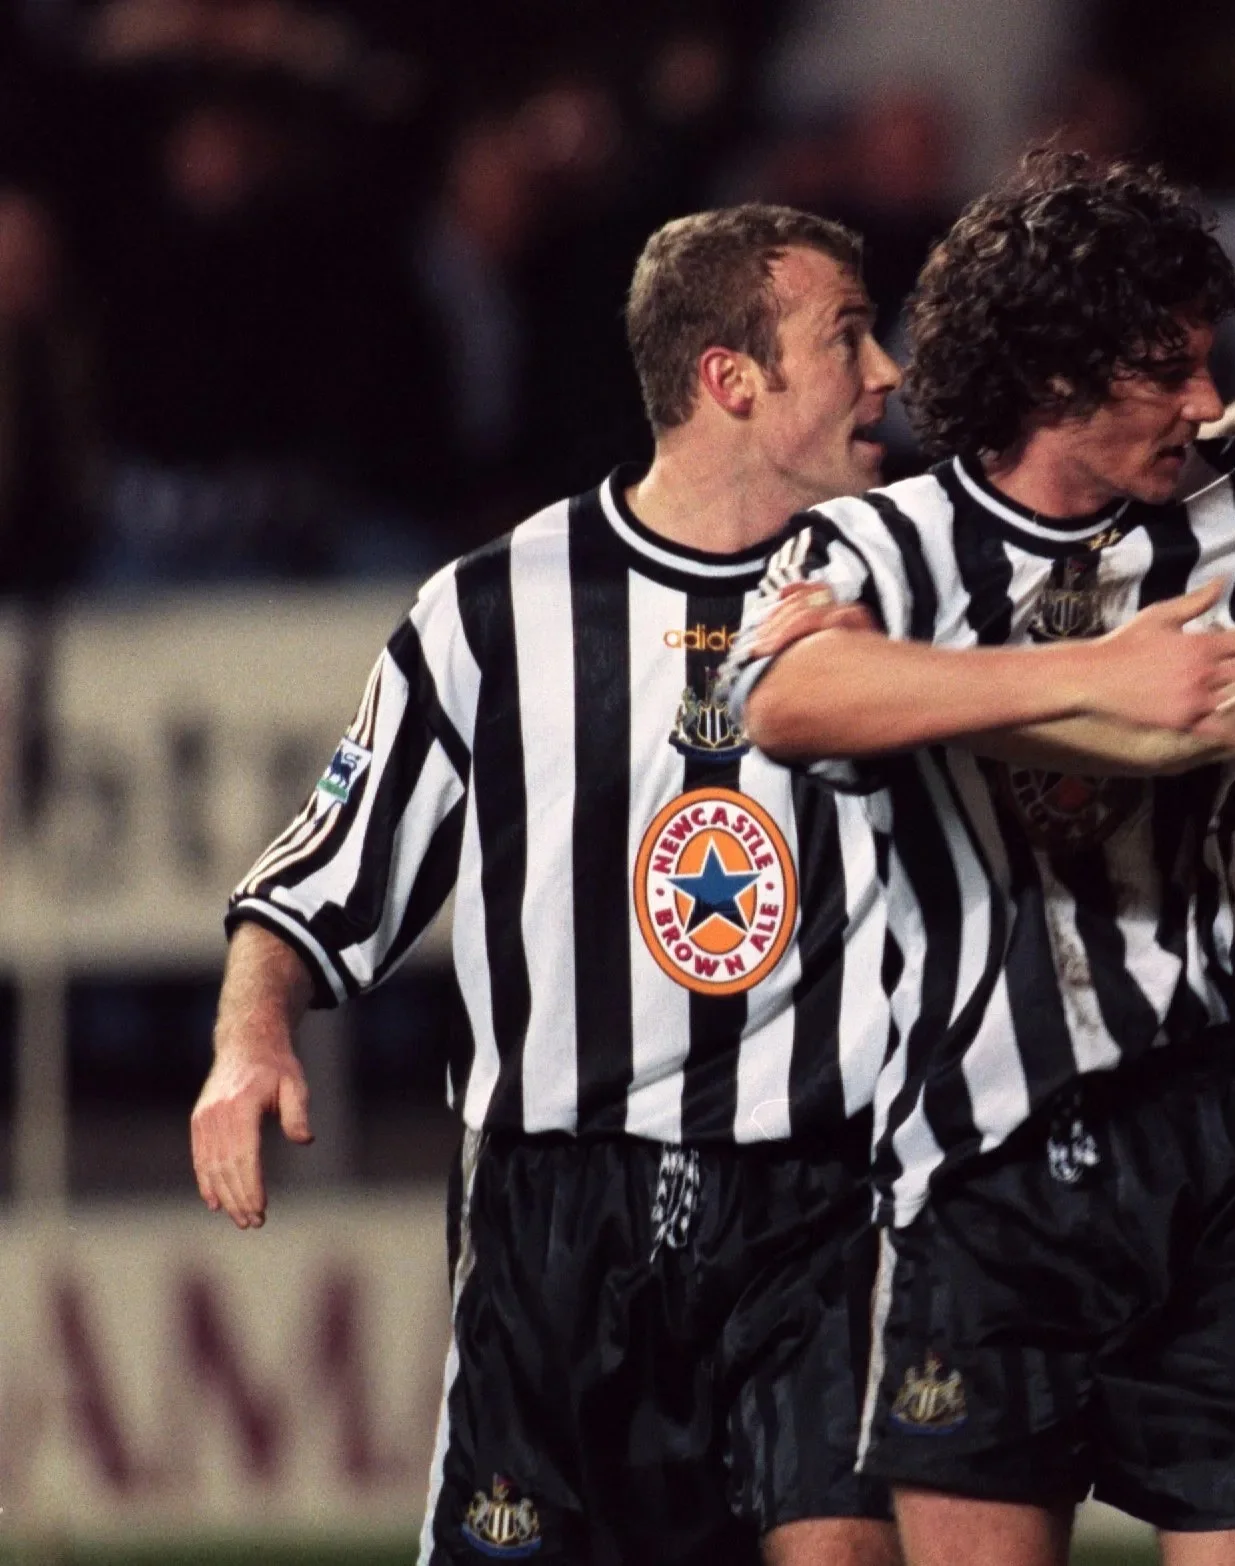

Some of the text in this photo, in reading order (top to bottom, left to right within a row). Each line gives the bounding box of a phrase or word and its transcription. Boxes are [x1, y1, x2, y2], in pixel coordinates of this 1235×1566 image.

[663, 623, 740, 650] adid
[653, 807, 774, 874] NEWCASTLE
[655, 903, 779, 977] BROWN ALE
